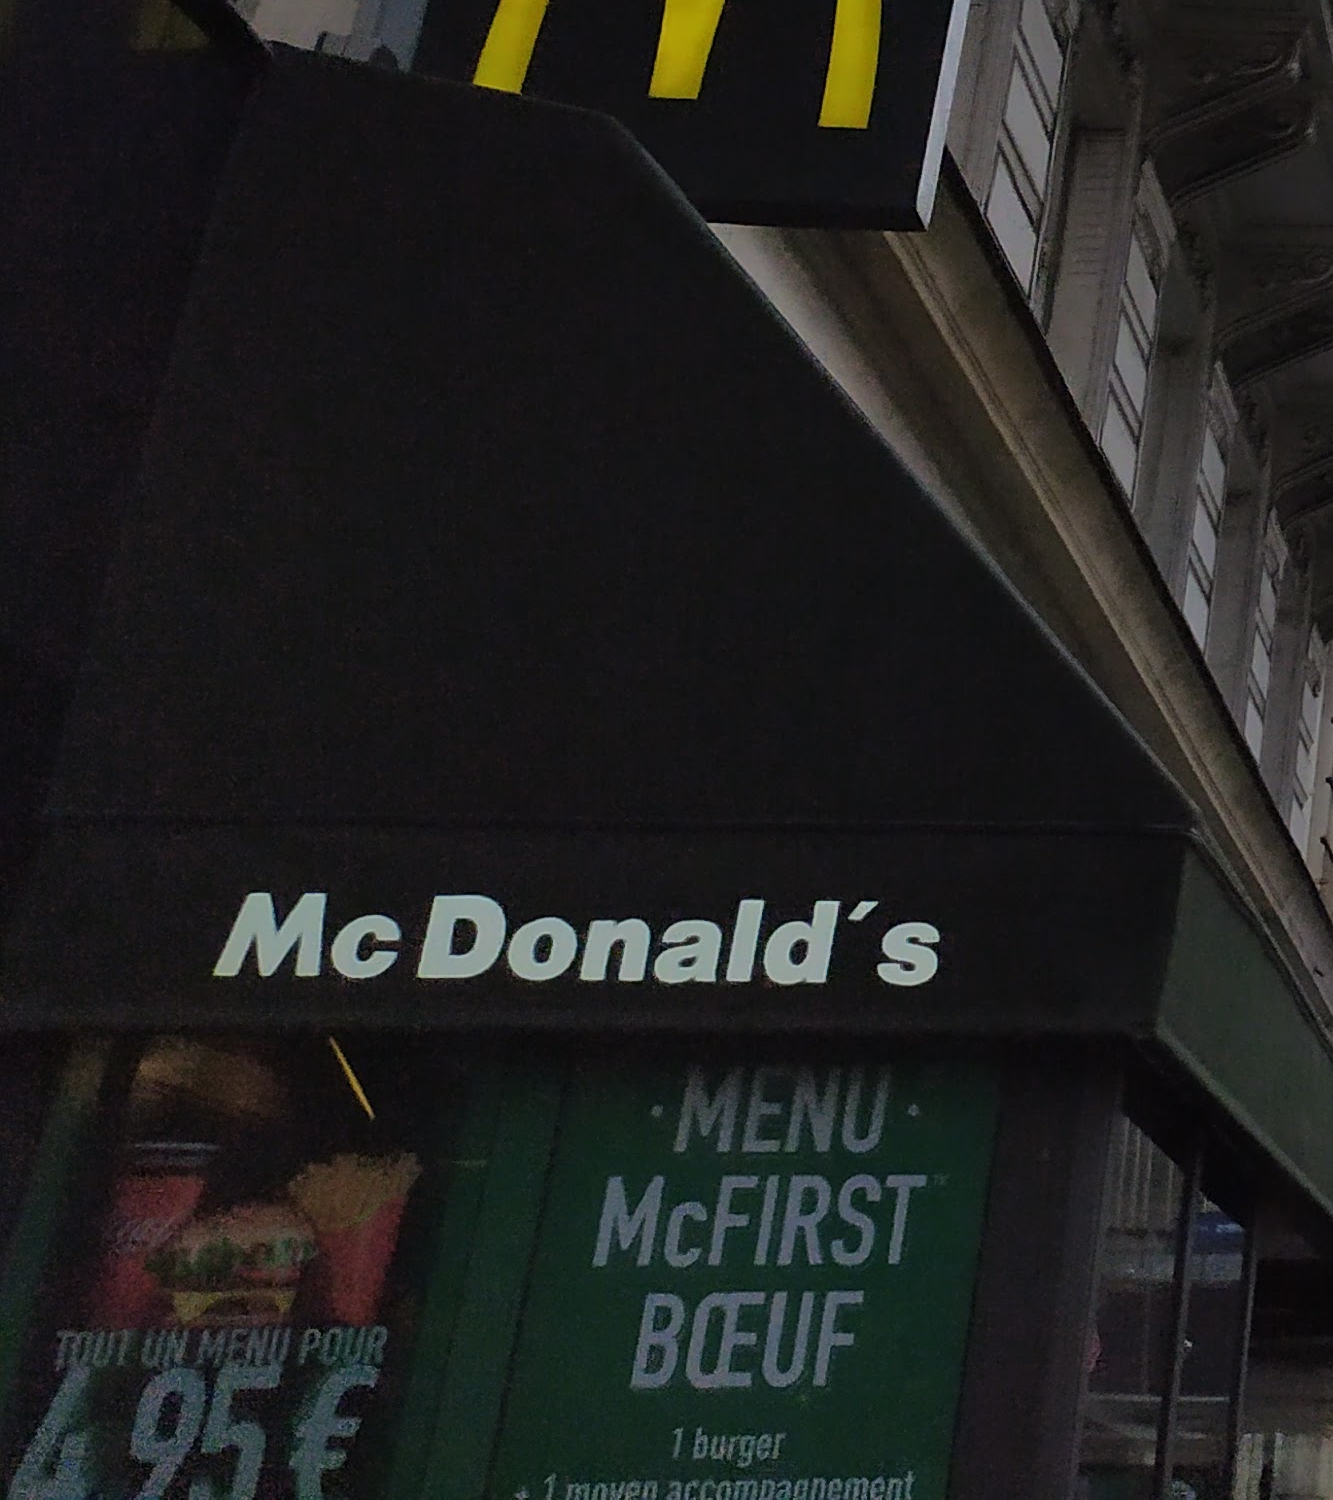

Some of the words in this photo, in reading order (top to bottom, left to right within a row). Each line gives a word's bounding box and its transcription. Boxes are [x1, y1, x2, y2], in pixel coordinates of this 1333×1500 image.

[674, 1064, 892, 1153] MENU
[592, 1173, 928, 1268] McFIRST
[54, 1329, 138, 1372] TOUT
[141, 1327, 190, 1367] UN
[195, 1326, 293, 1368] MENU
[297, 1324, 390, 1366] POUR
[629, 1290, 864, 1391] BŒUF
[672, 1428, 685, 1459] 1
[692, 1427, 787, 1468] burger
[665, 1470, 917, 1500] accompagnement
